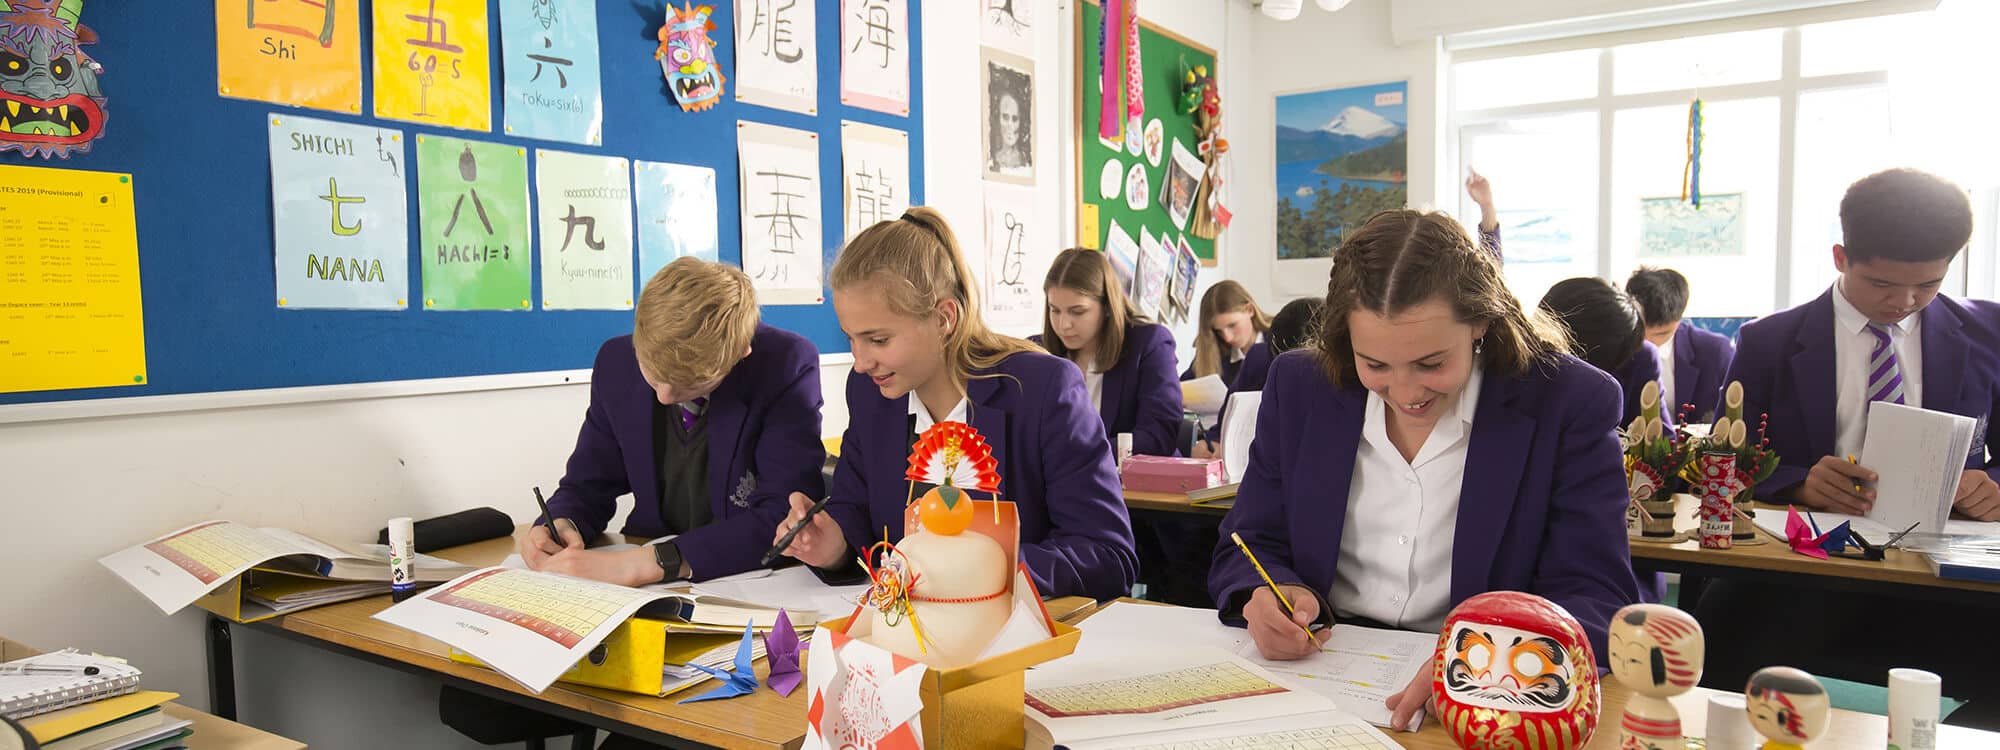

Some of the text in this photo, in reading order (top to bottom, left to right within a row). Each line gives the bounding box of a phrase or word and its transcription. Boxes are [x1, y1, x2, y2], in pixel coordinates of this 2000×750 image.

[259, 37, 296, 60] Shi
[526, 36, 574, 89] 六
[290, 131, 354, 156] SHICHI
[16, 186, 36, 195] 2019
[319, 176, 367, 236] 七
[558, 204, 606, 252] 九
[306, 253, 385, 283] NANA
